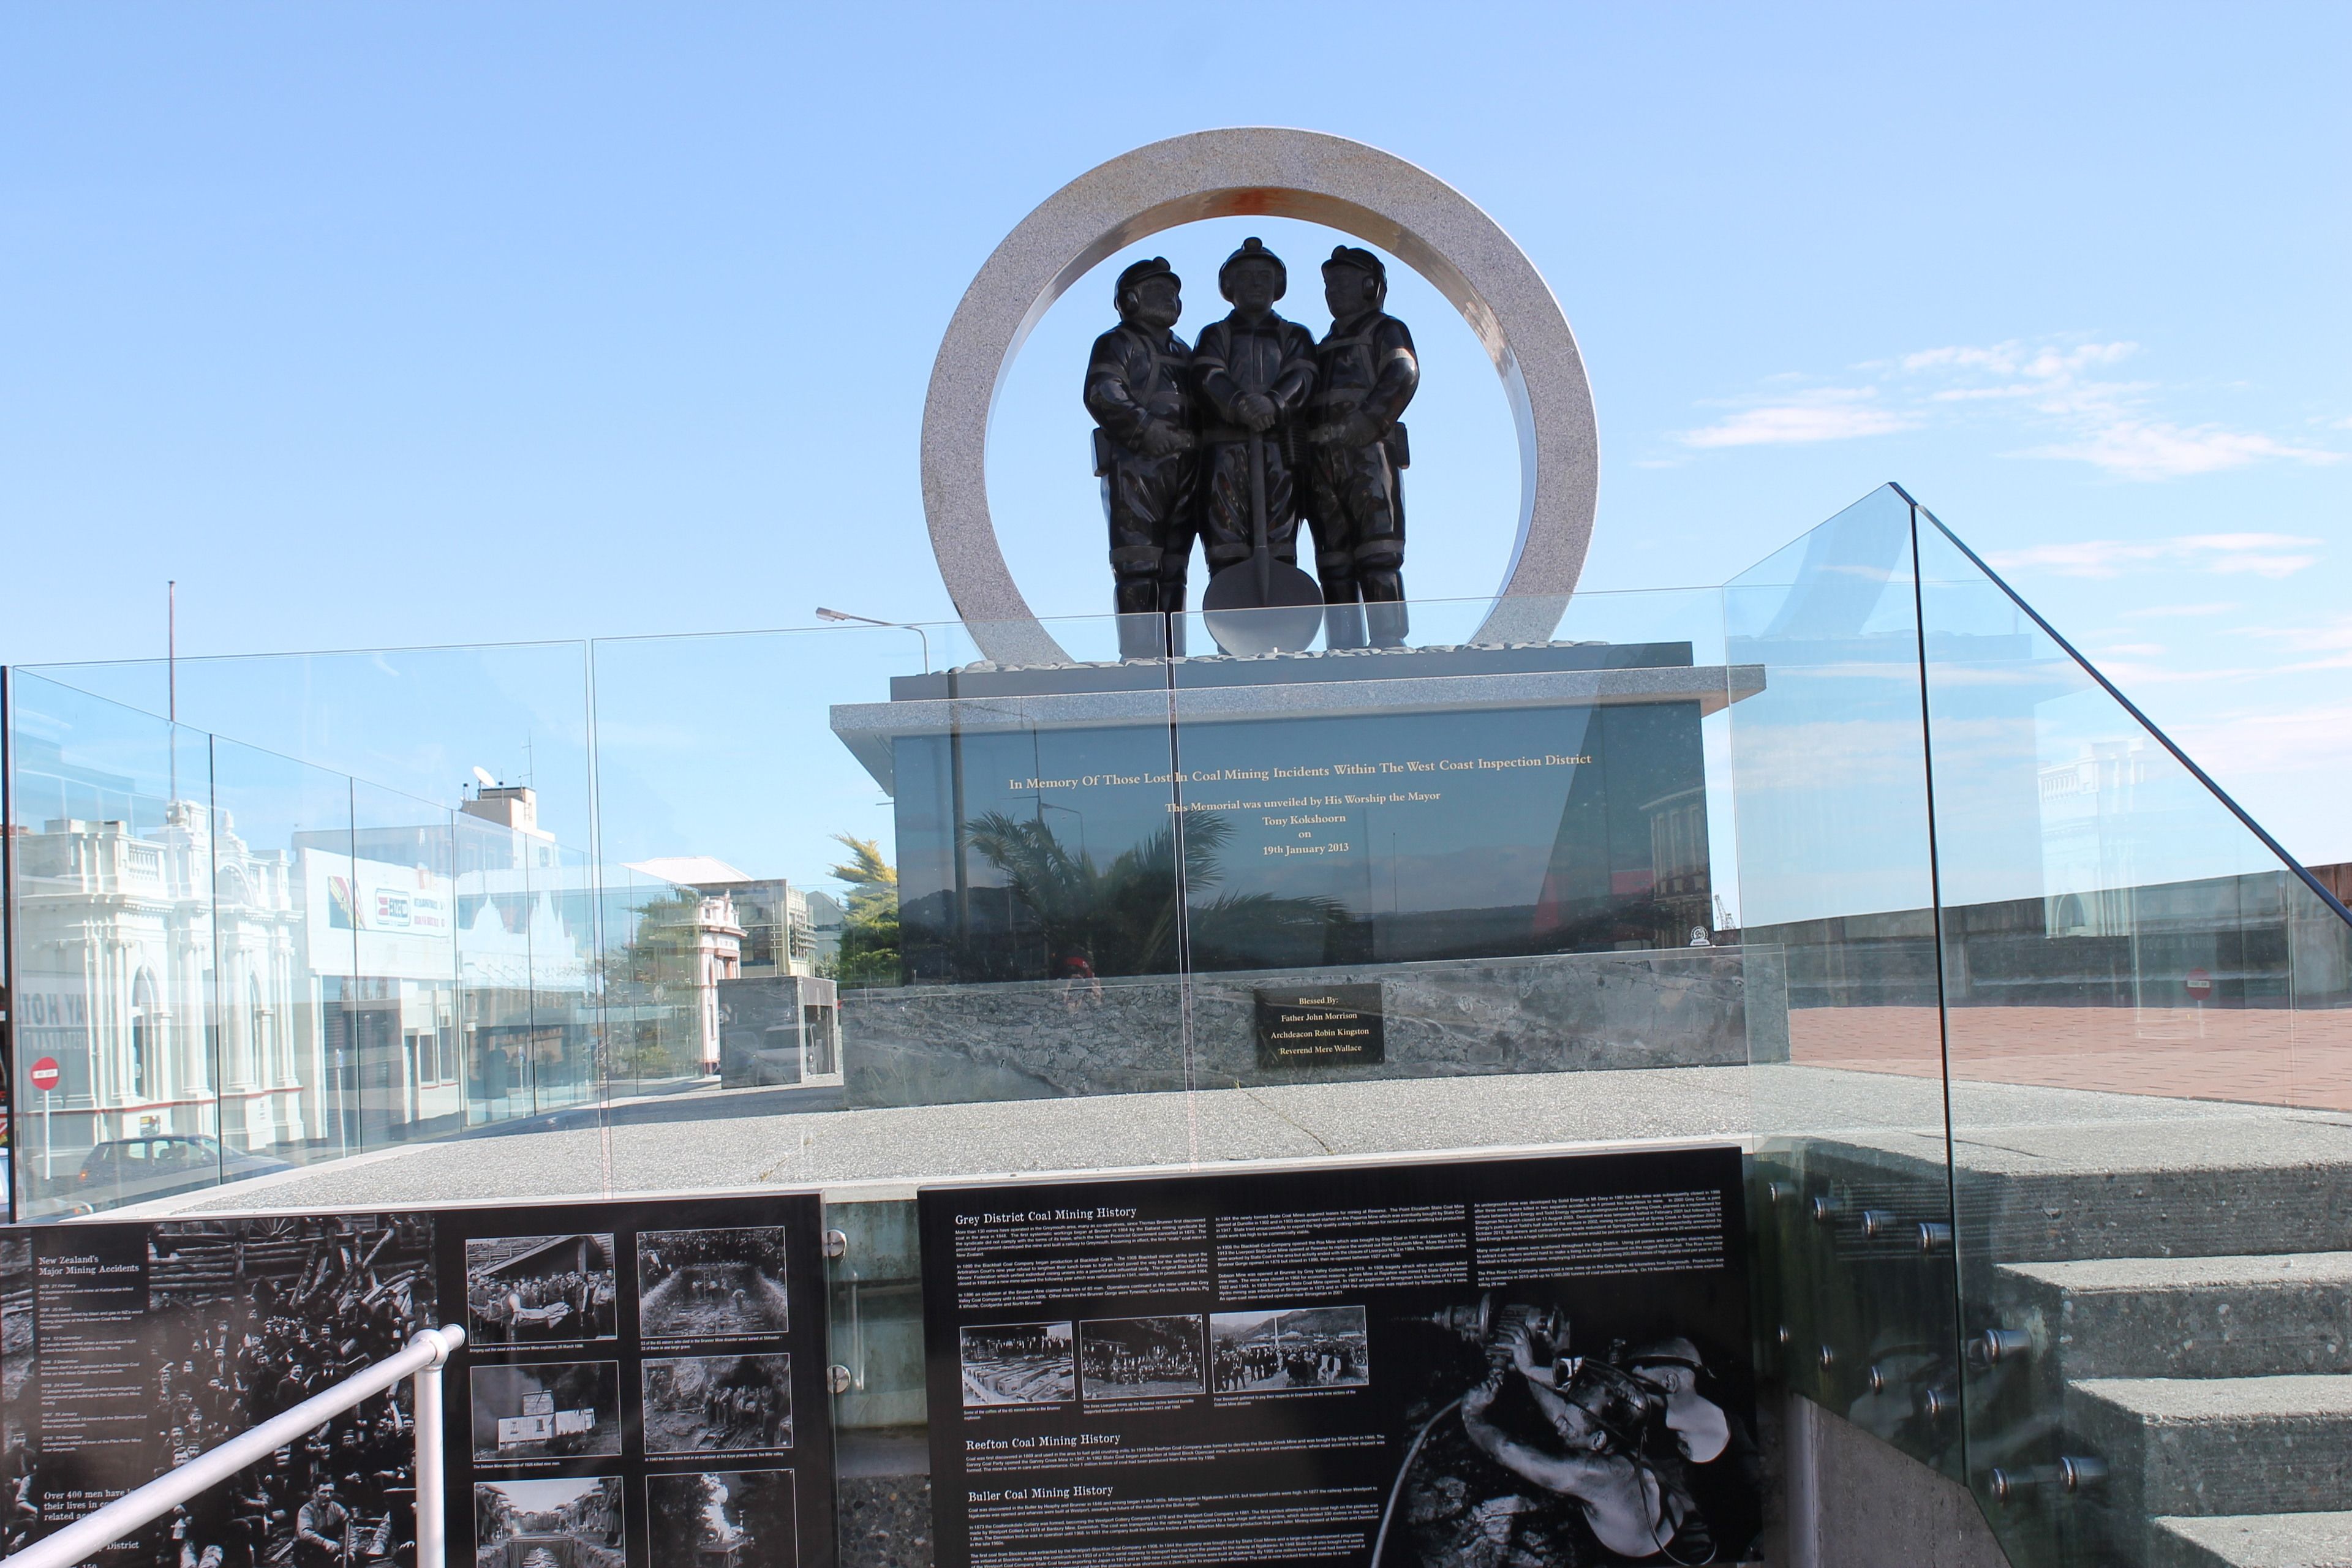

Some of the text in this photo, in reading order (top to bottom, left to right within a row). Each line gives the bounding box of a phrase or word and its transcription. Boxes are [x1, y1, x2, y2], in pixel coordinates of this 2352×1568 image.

[1010, 753, 1590, 789] In Memory Of Those Lost In Coal Mining Incidents Within The West Coast Inspection District
[1191, 800, 1240, 810] Memorial
[1264, 797, 1306, 807] unveiled
[1310, 796, 1322, 807] by
[1324, 796, 1341, 804] His
[1344, 793, 1385, 805] Worship
[1389, 792, 1404, 801] the
[1408, 791, 1440, 800] Mayor
[1262, 813, 1345, 827] Tony Kokshoorn
[1264, 843, 1348, 856] 19th January 2013
[1337, 1028, 1369, 1036] Kingston
[955, 1206, 1136, 1226] Grey District Coal Mining History
[59, 1255, 98, 1264] Zealand's
[39, 1264, 139, 1277] Major Mining Accidents
[965, 1433, 1120, 1450] Reefton Coal Mining History
[44, 1491, 64, 1499] Over
[968, 1485, 1112, 1501] Buller Coal Mining History
[43, 1512, 74, 1520] related
[107, 1541, 140, 1550] District
